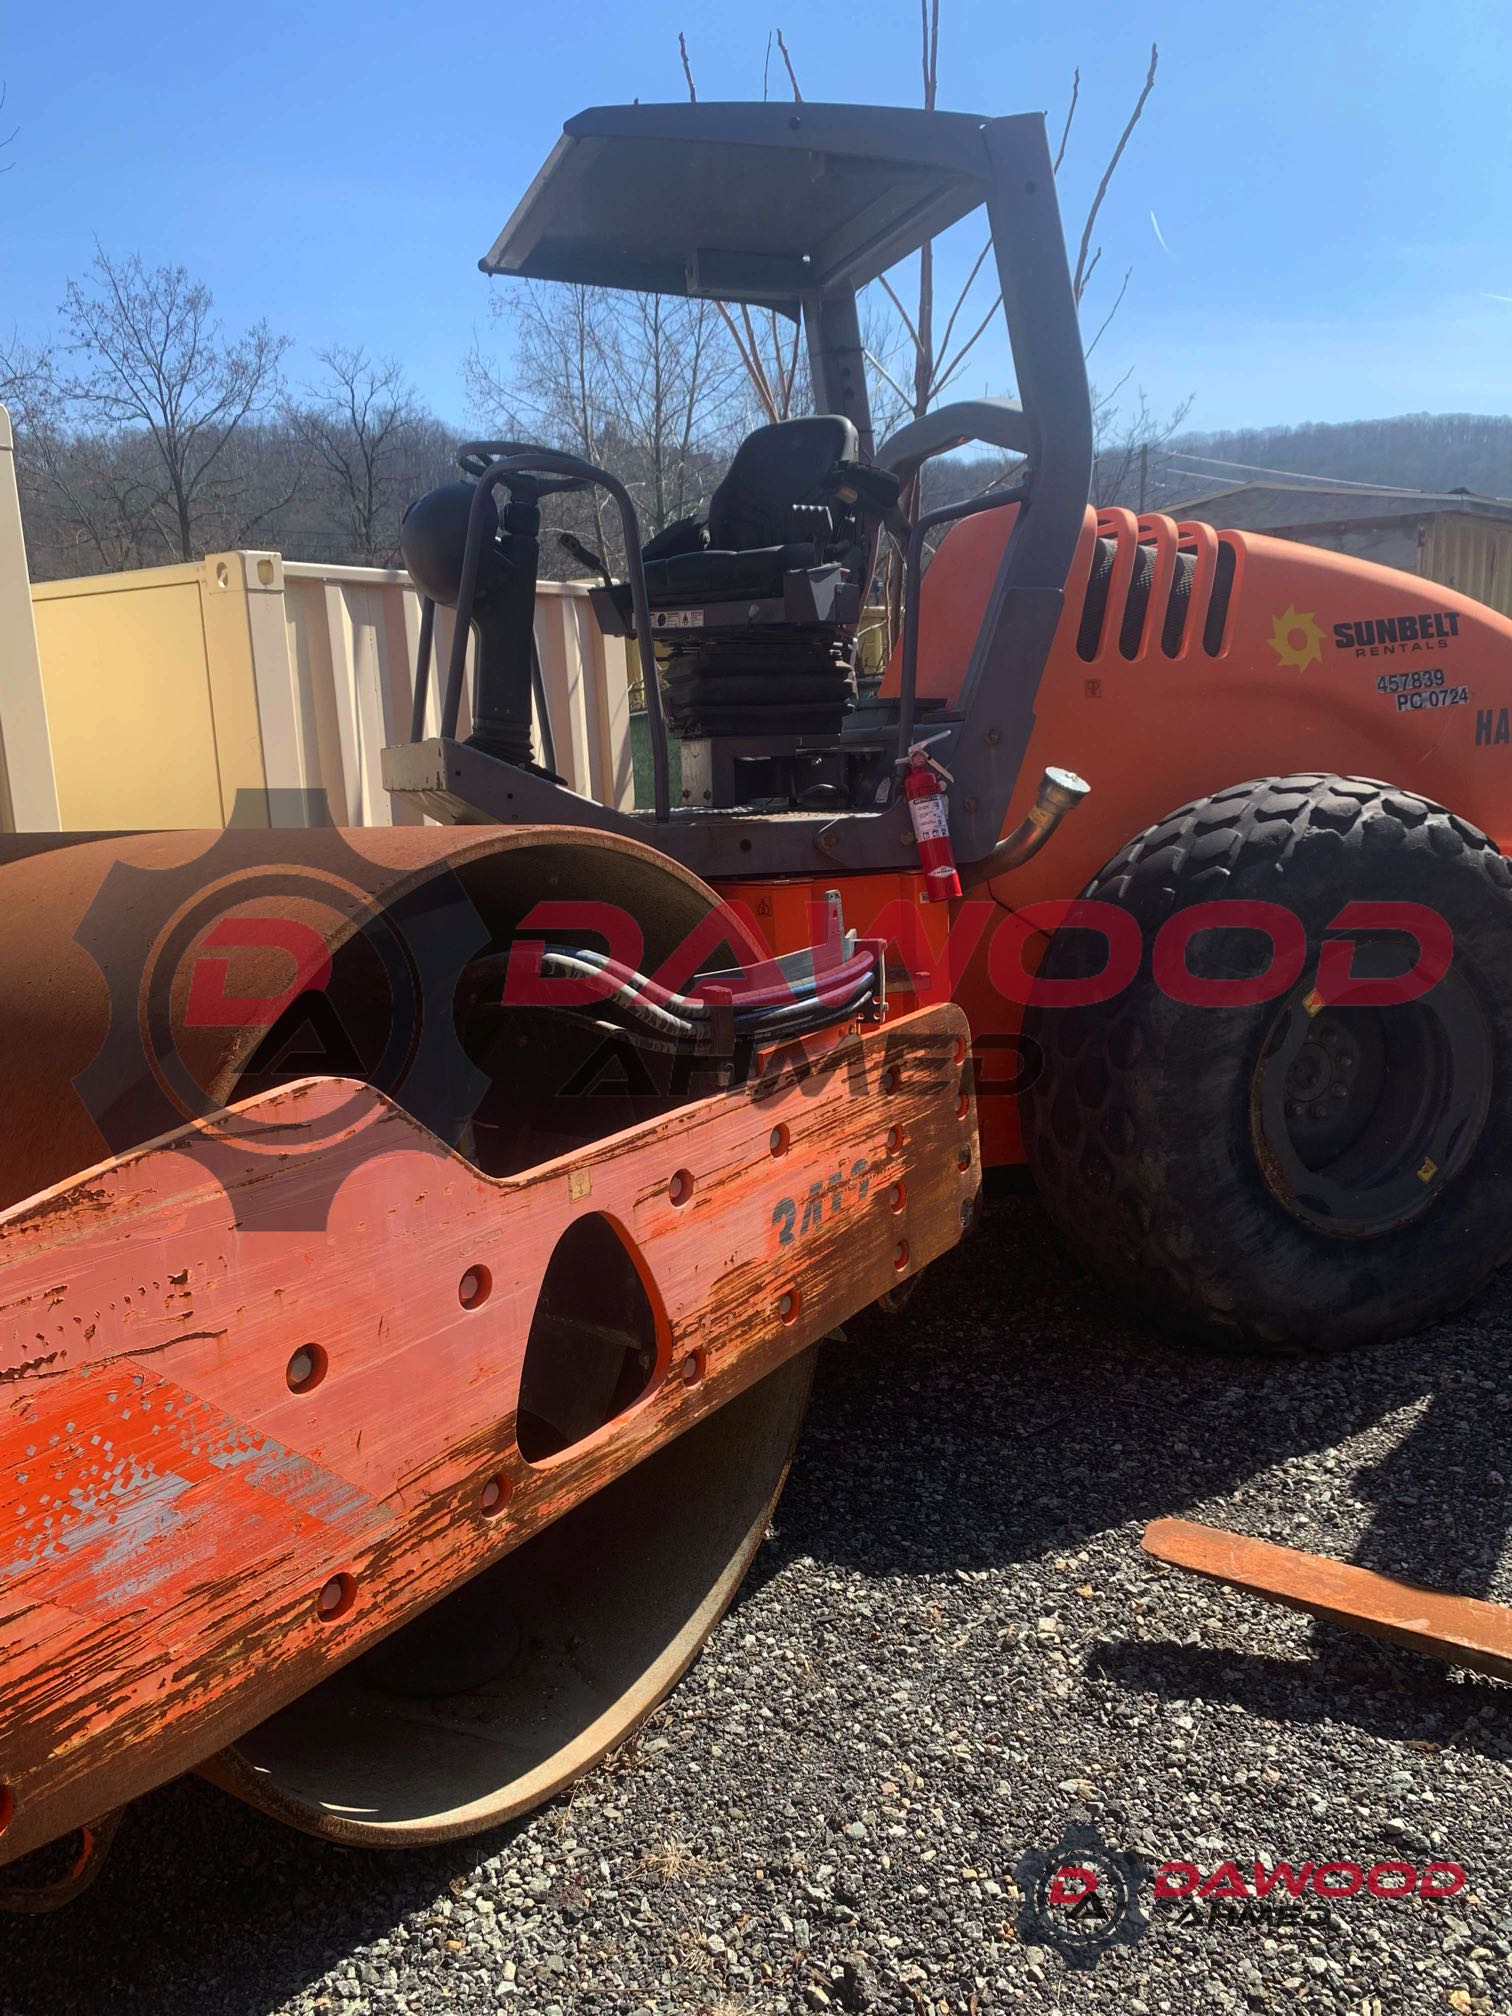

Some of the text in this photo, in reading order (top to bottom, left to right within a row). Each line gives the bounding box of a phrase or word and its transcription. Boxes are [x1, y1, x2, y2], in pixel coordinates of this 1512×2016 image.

[1333, 612, 1459, 649] SUNBELT
[1355, 640, 1448, 658] RENTALS
[1377, 669, 1444, 692] 457839
